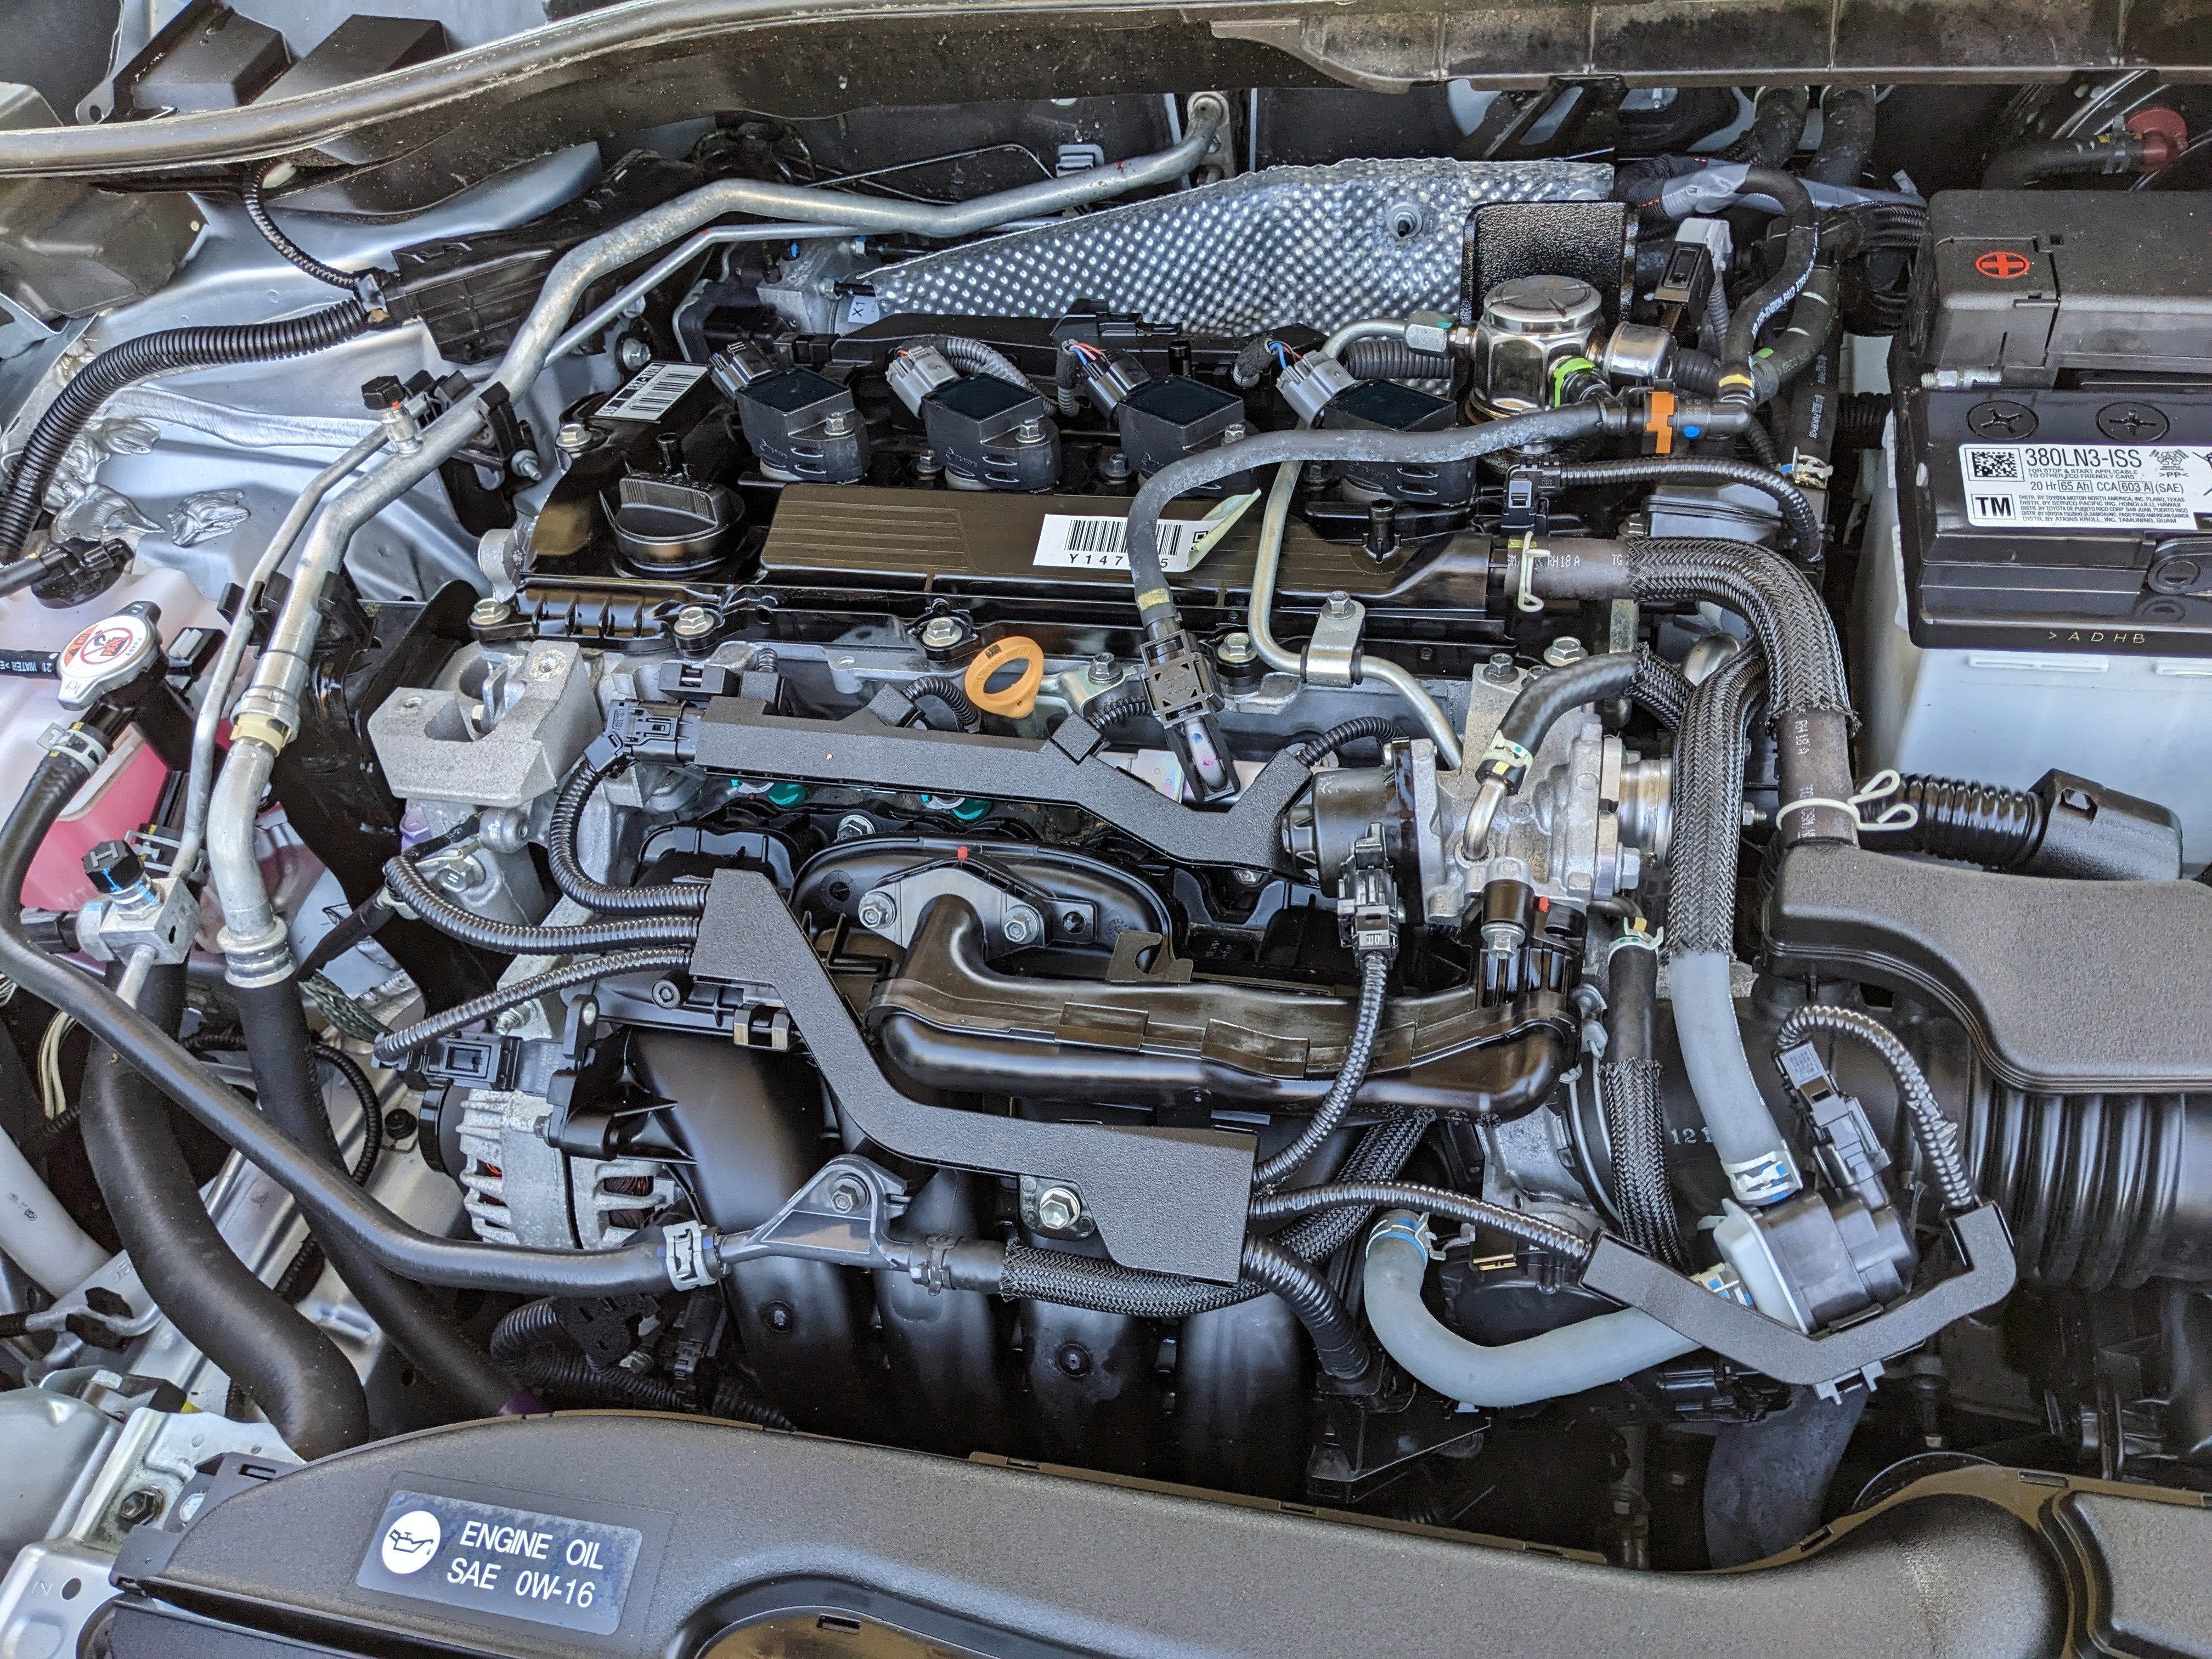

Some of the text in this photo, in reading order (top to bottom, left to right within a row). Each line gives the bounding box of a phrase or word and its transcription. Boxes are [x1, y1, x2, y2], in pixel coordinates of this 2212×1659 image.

[2025, 448, 2142, 467] 380LN3-ISS
[2030, 482, 2183, 494] 20 Hr 65 Ah CCA 603 A (SAE)
[1975, 497, 2011, 517] TM
[1070, 554, 1168, 568] Y1475
[12, 661, 37, 672] WATER
[460, 1520, 603, 1570] ENGINE OIL
[447, 1557, 595, 1608] SAE 0W-16
